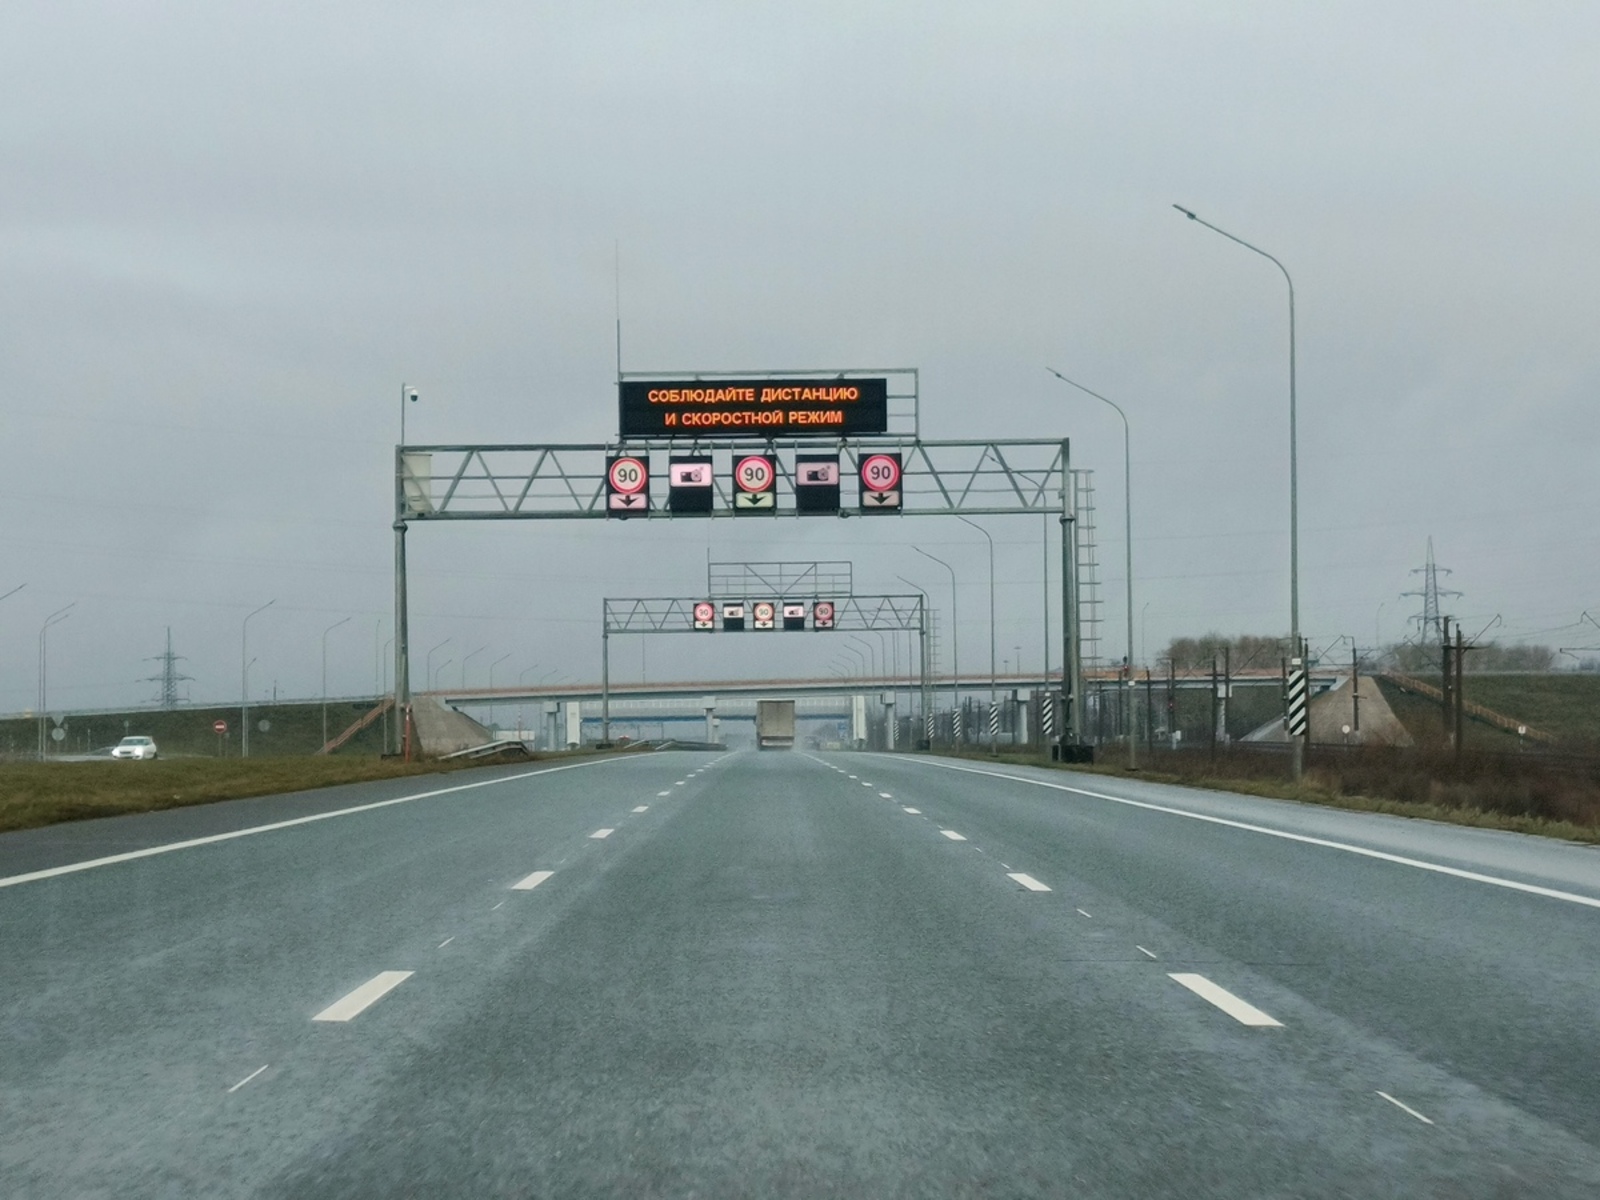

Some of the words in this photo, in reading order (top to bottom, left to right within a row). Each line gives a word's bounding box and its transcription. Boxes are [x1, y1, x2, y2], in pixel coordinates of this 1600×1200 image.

[648, 387, 755, 403] СОБЛЮДАЙТЕ
[761, 387, 858, 402] ДИСТАНЦИЮ
[665, 412, 676, 425] И
[682, 410, 784, 425] СКОРОСТНОЙ
[789, 411, 843, 424] РЕЖИМ
[617, 468, 638, 483] 90
[744, 467, 765, 482] 90
[870, 465, 891, 480] 90
